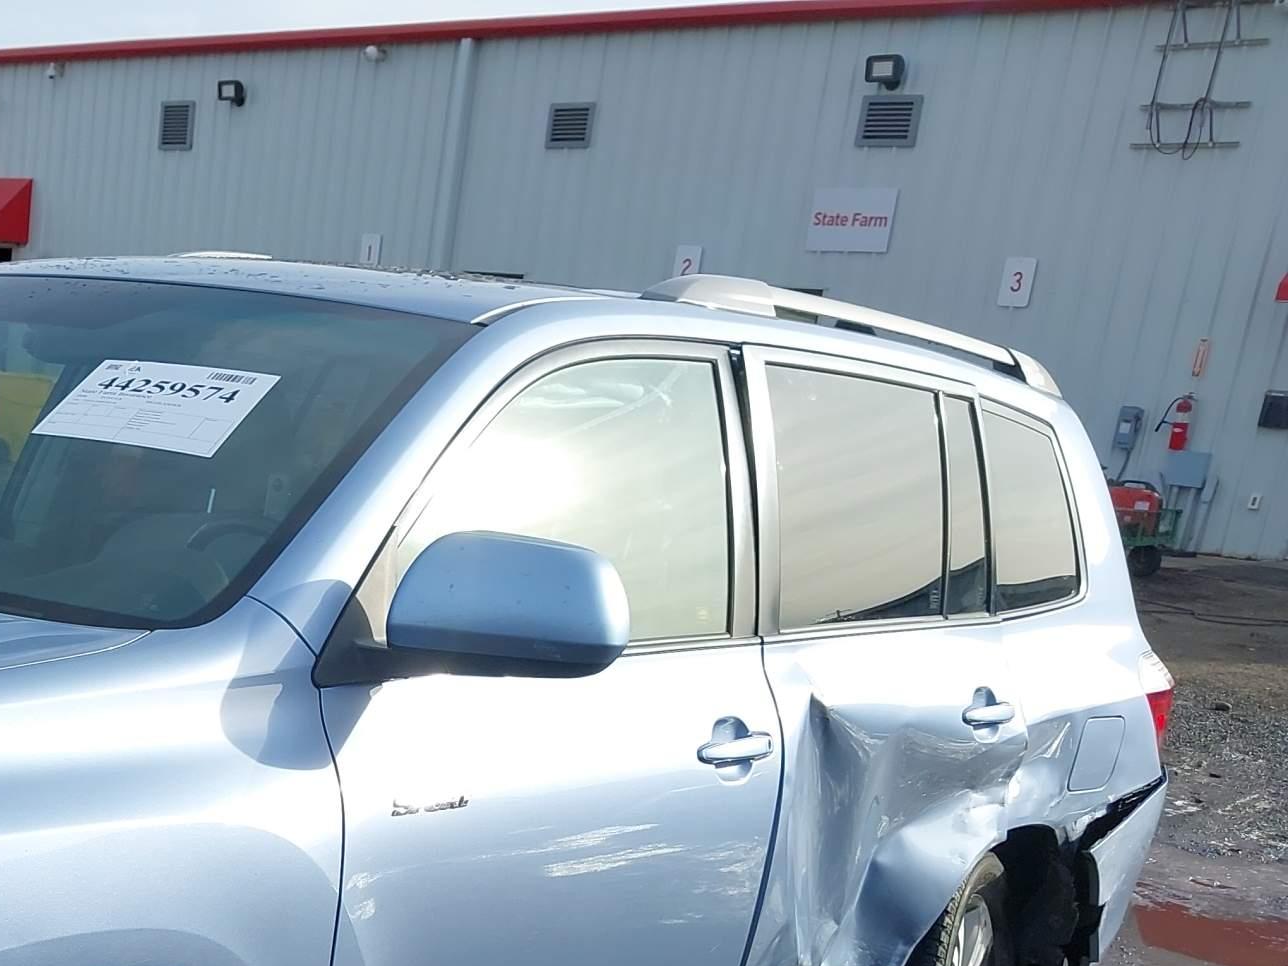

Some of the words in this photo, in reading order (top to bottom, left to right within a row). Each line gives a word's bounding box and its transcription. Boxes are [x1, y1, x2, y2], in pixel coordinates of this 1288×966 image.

[812, 211, 849, 227] State
[850, 212, 889, 228] Farm
[679, 257, 692, 276] 2
[1009, 271, 1024, 293] 3
[97, 375, 241, 404] 44259574
